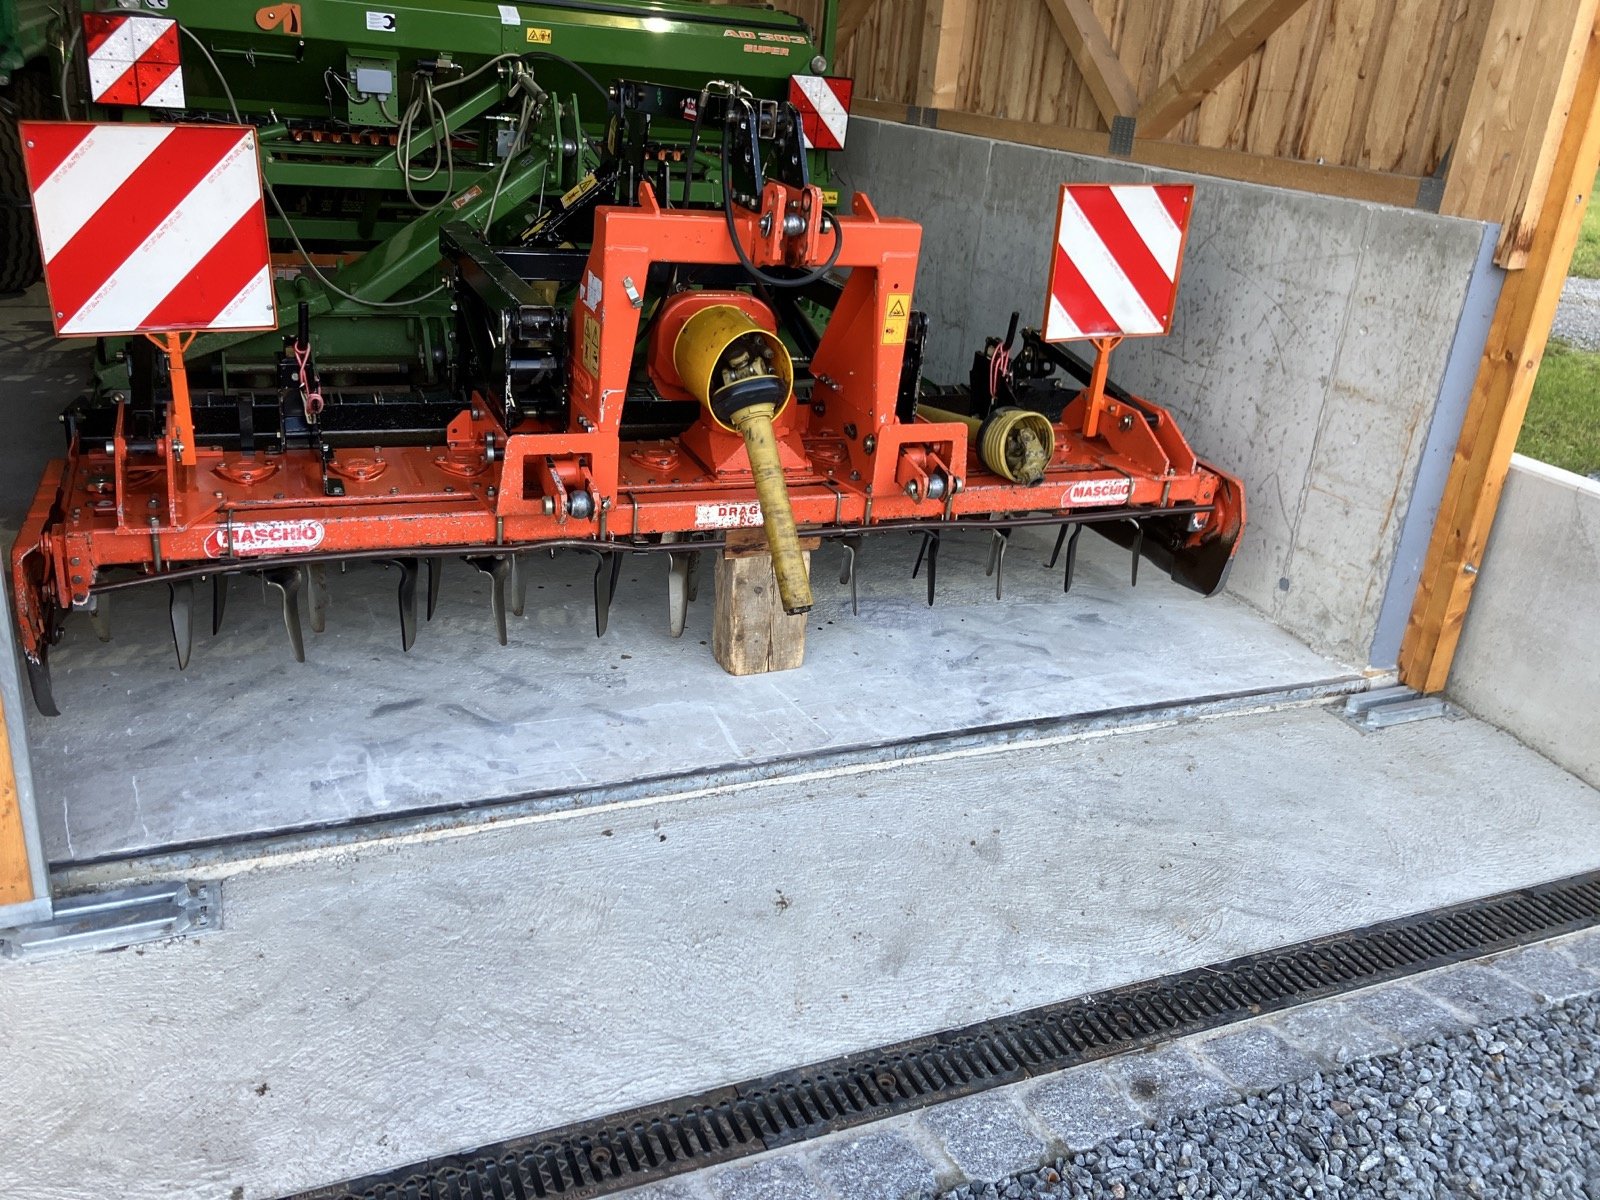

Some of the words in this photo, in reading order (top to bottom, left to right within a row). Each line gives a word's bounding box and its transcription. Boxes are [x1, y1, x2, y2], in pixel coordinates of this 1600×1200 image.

[724, 29, 756, 39] AD
[758, 32, 807, 44] 303
[743, 43, 789, 56] SUPER
[1073, 484, 1130, 498] MASCHIO
[718, 506, 759, 517] DRAG
[222, 526, 317, 544] MASCHIO
